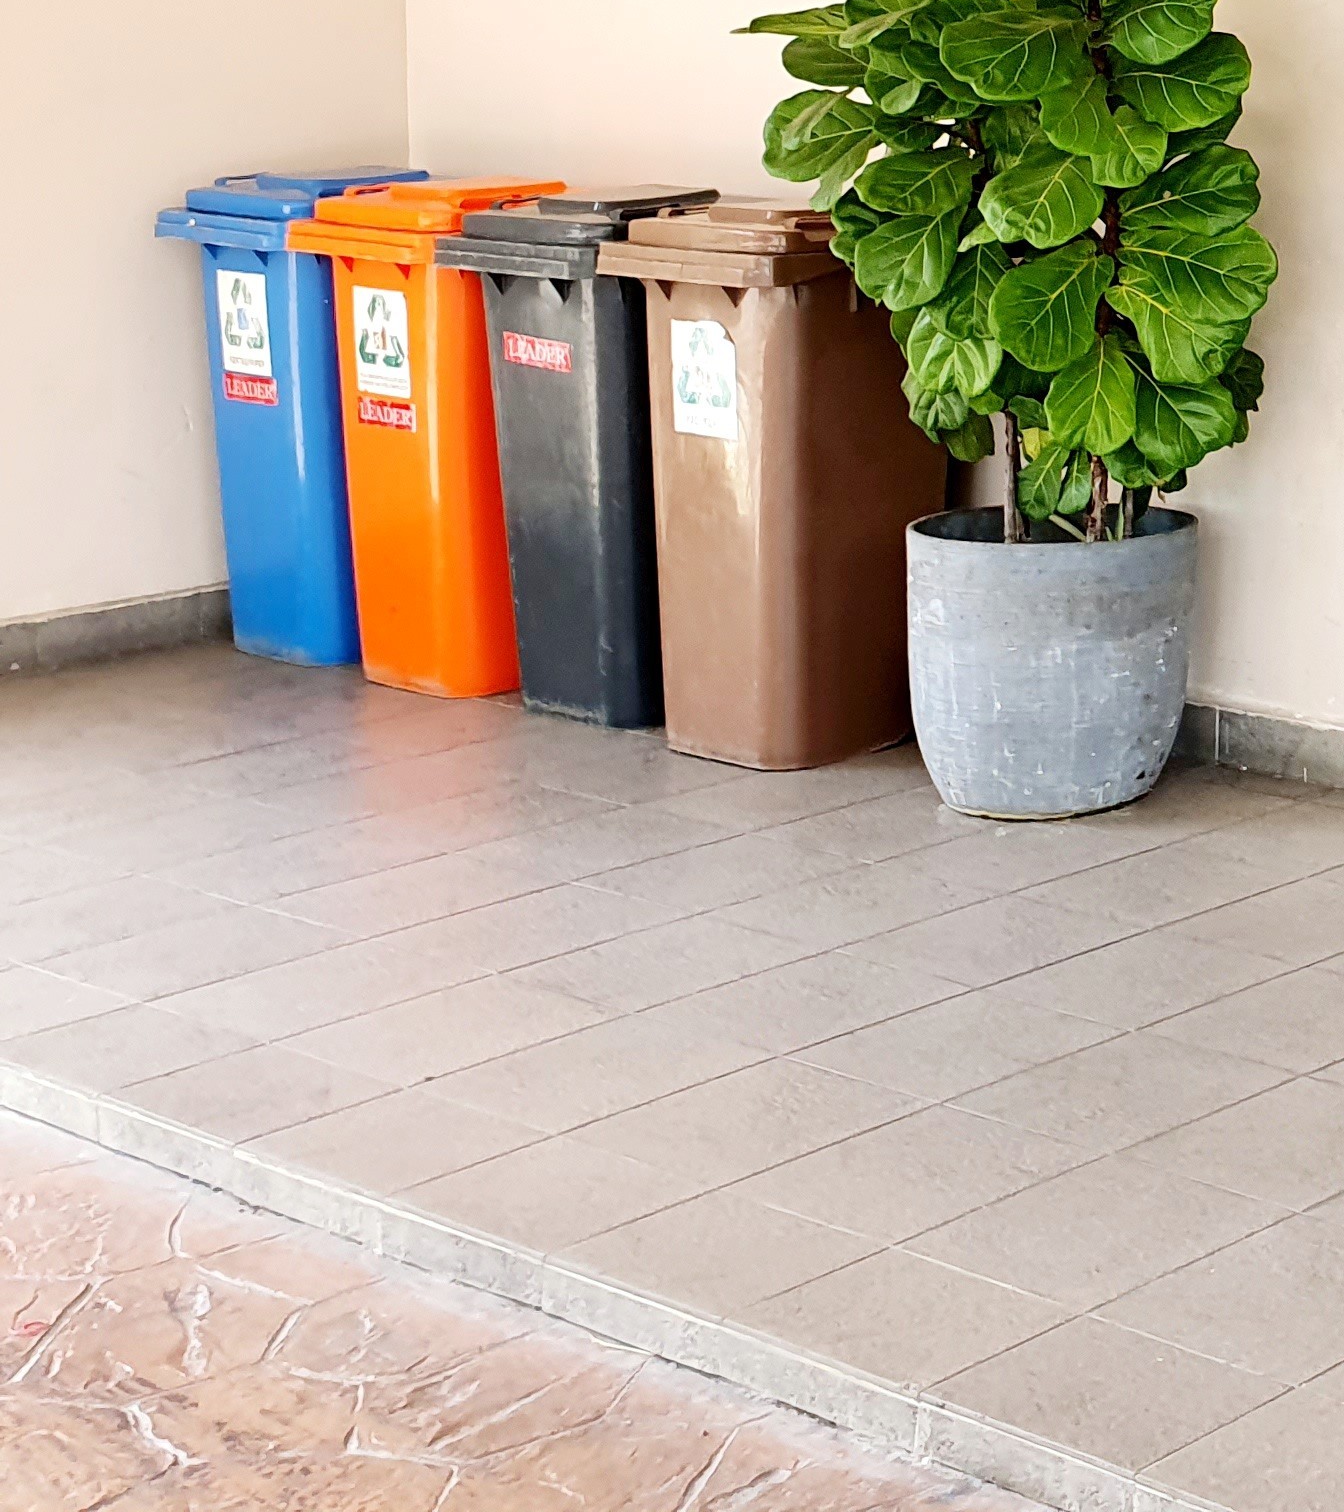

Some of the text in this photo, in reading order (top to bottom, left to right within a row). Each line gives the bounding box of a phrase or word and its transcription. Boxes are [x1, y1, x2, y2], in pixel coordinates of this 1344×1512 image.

[507, 338, 567, 366] LEADER
[226, 377, 276, 400] LEADER
[359, 401, 413, 426] LEADER
